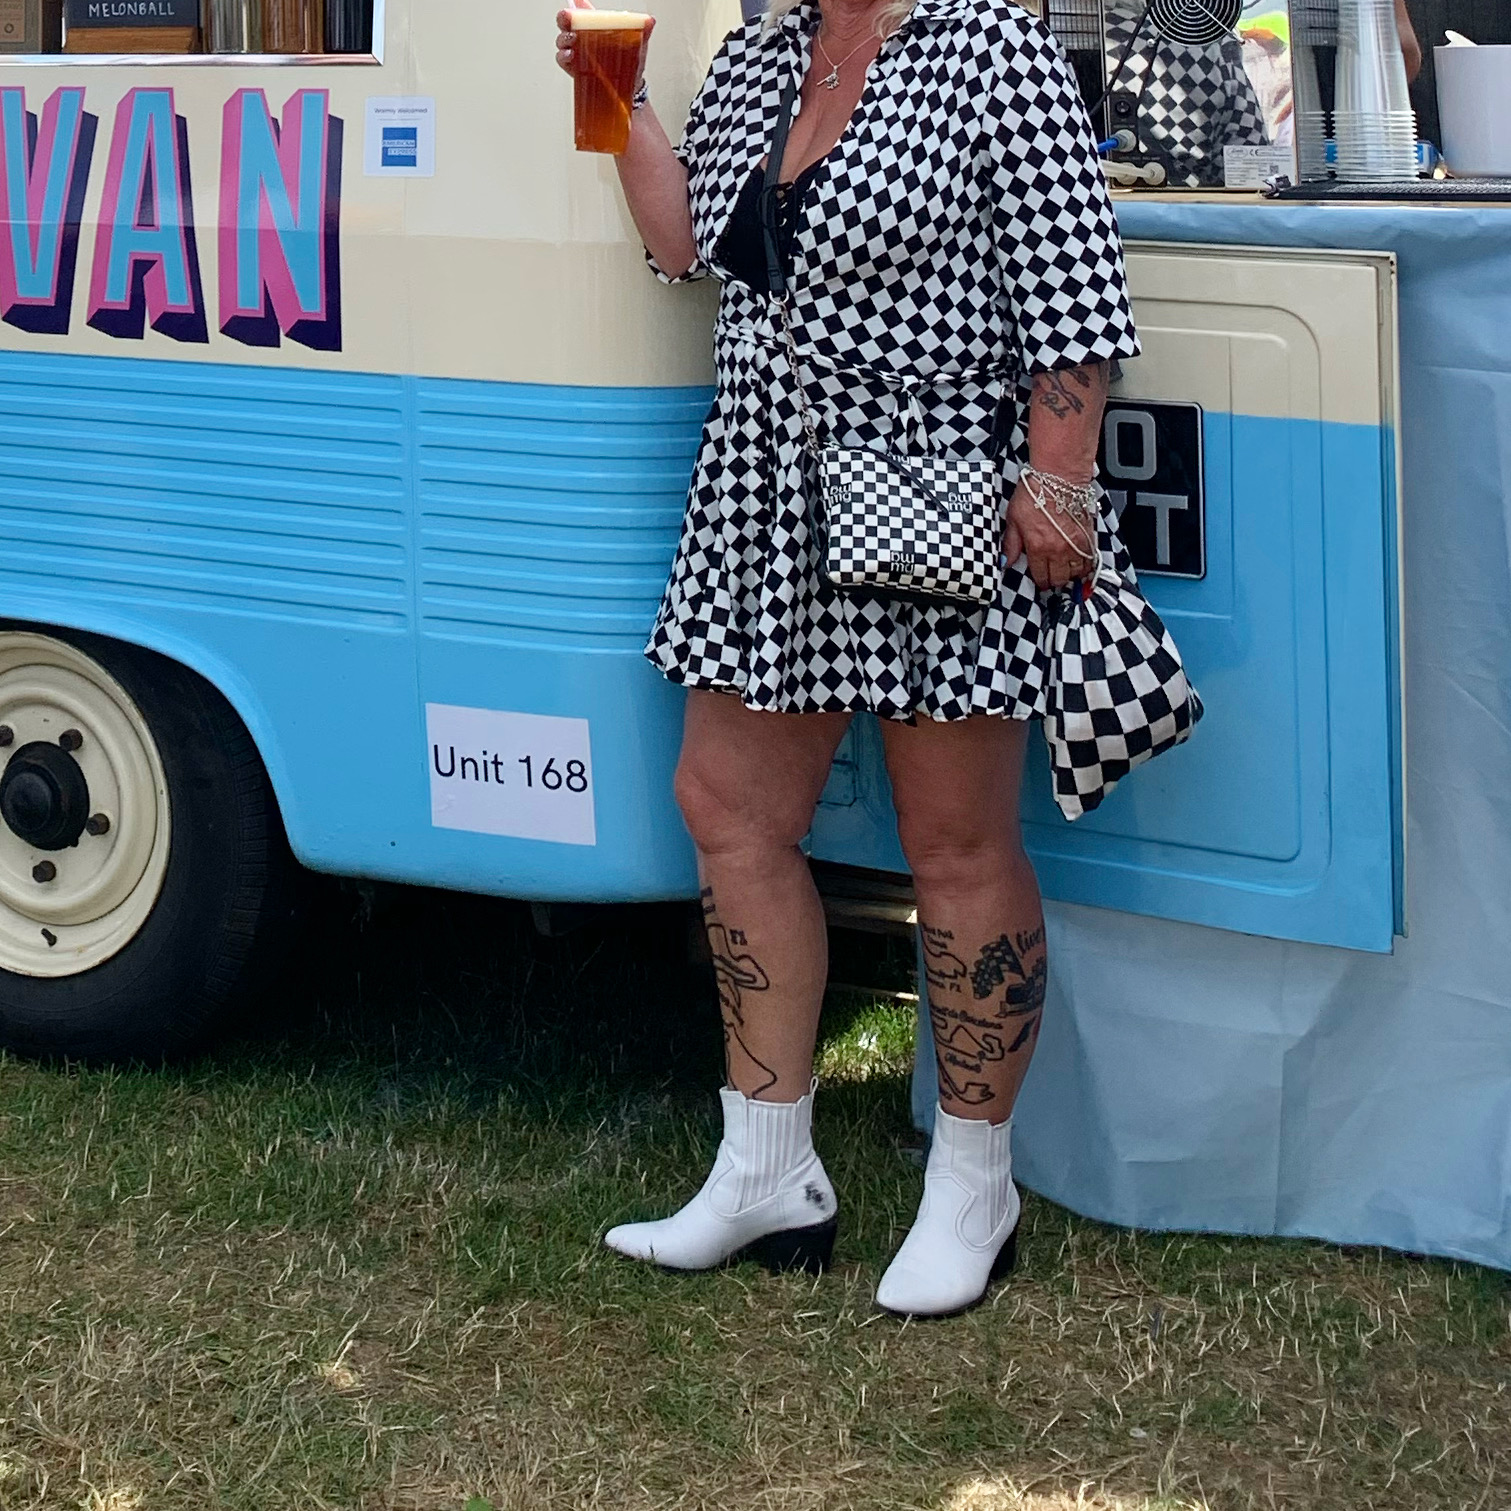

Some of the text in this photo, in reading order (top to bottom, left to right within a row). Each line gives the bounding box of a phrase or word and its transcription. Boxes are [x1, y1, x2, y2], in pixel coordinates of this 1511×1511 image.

[89, 2, 175, 18] MELONBALL
[434, 744, 588, 792] Unit 168
